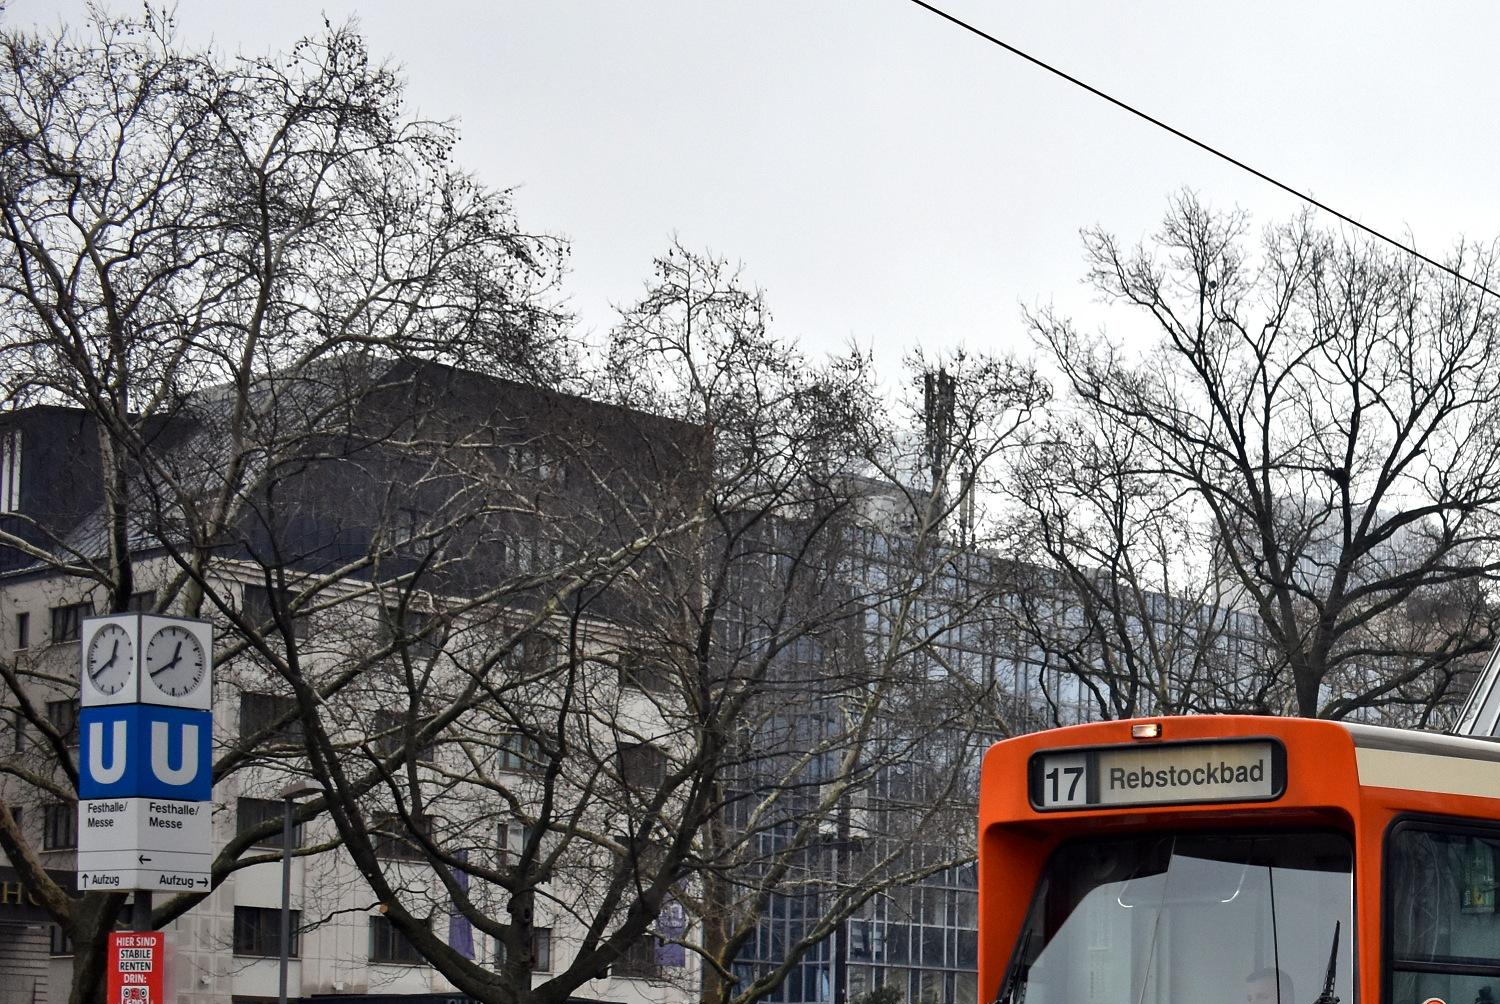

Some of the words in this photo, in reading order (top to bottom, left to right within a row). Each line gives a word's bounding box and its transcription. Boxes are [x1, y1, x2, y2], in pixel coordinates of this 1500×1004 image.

[89, 720, 127, 785] U
[151, 721, 199, 786] U
[1046, 767, 1084, 802] 17
[1110, 759, 1264, 790] Rebstockbad
[87, 801, 128, 814] Festhalle/
[149, 802, 200, 816] Festhalle/
[87, 817, 114, 828] Messe
[149, 817, 183, 829] Messe
[91, 874, 120, 886] Aufzug
[159, 875, 194, 888] Aufzug
[116, 937, 135, 947] HIER
[136, 937, 157, 947] SIND
[120, 949, 151, 959] STABILE
[120, 961, 151, 971] RENTEN
[123, 973, 147, 984] DRIN:
